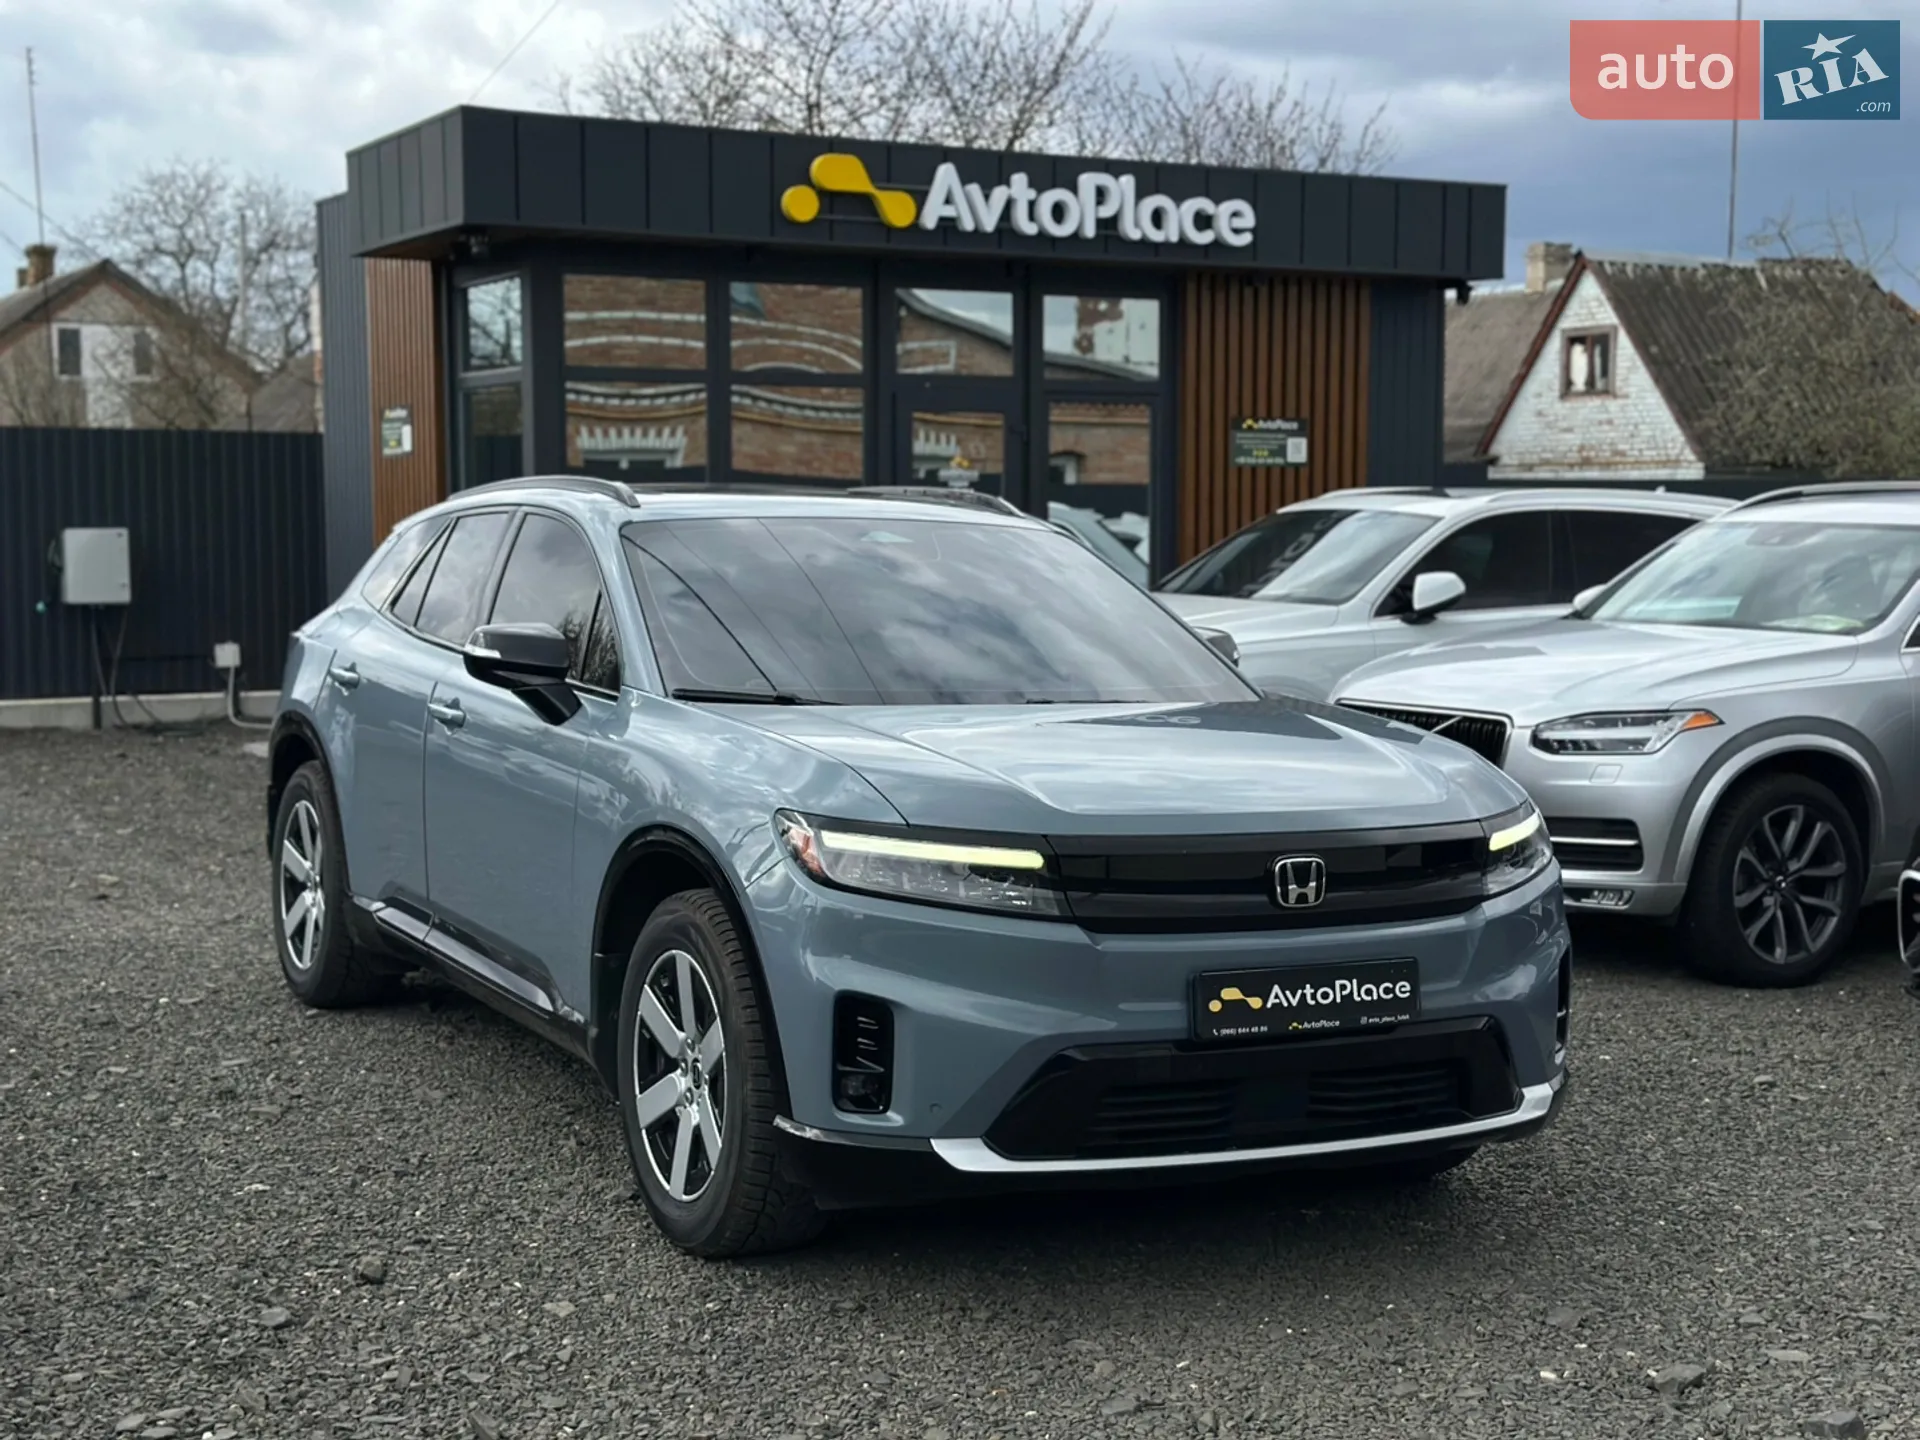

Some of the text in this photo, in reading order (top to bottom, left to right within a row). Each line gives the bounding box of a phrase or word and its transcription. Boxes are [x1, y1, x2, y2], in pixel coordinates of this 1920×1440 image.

[919, 161, 1256, 248] AvtoPlace
[1266, 978, 1412, 1009] AvtoPlace
[1302, 1020, 1340, 1029] AvtoPlace
